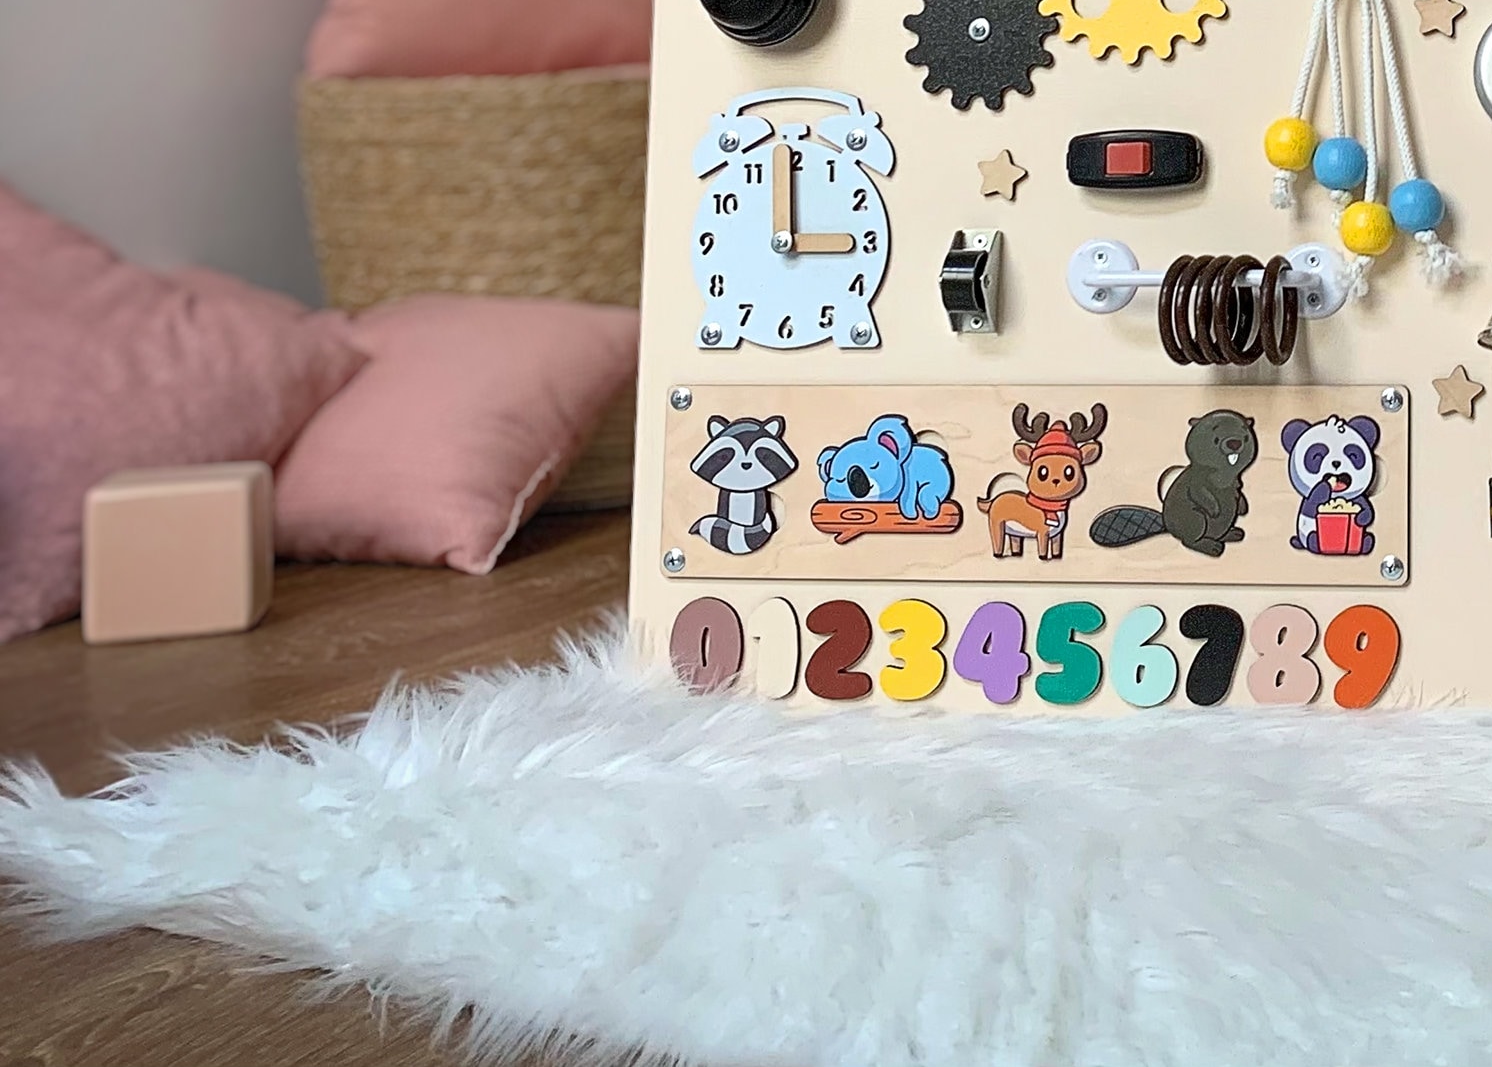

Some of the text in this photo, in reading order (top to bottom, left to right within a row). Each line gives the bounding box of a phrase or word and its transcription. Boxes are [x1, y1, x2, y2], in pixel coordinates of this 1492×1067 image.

[744, 163, 762, 184] 11
[826, 160, 836, 182] 1
[713, 193, 738, 214] 10
[852, 188, 868, 211] 2
[699, 232, 715, 255] 9
[863, 230, 877, 254] 3
[709, 274, 724, 297] 8
[848, 273, 864, 296] 4
[738, 304, 754, 327] 7
[778, 315, 794, 339] 6
[818, 305, 835, 329] 5
